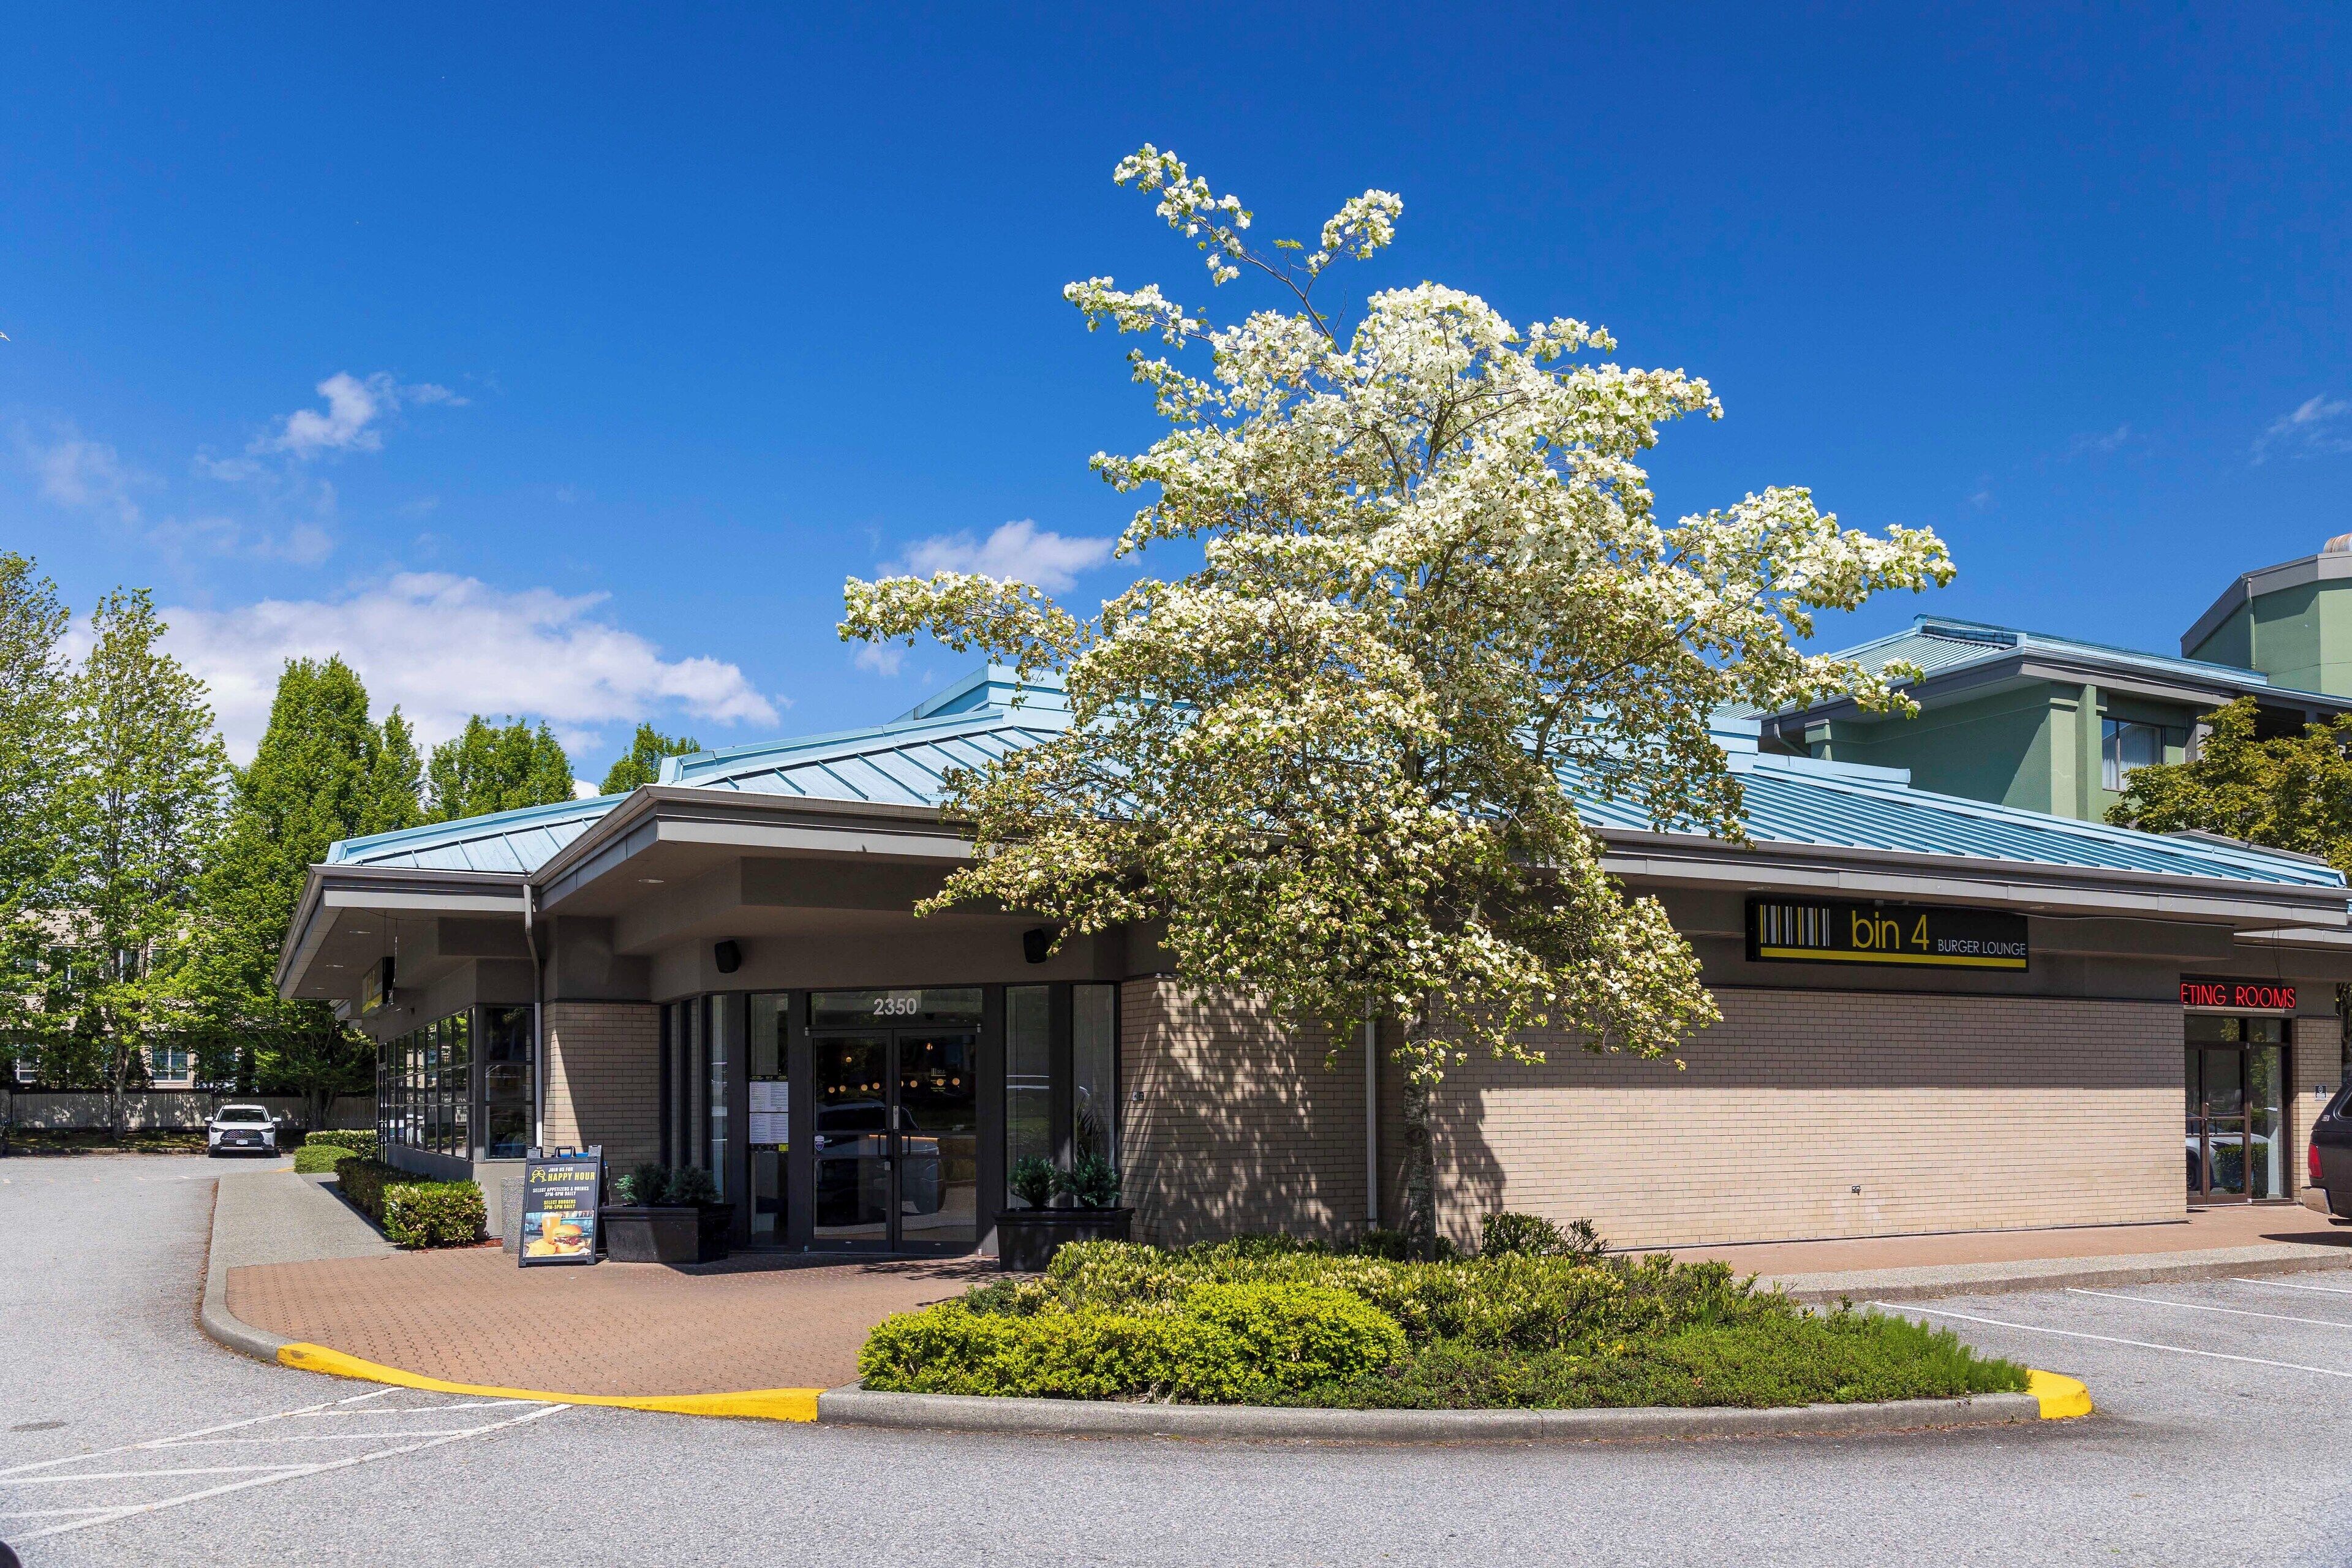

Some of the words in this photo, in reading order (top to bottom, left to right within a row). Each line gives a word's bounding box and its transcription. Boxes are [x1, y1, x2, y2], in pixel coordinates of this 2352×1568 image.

[1852, 910, 1899, 949] bin
[1911, 914, 1929, 951] 4
[1937, 939, 1979, 953] BURGER
[1982, 941, 2026, 956] LOUNGE
[2236, 986, 2295, 1008] ROOMS
[873, 998, 917, 1015] 2350
[548, 1172, 572, 1182] HAPPY
[575, 1172, 595, 1180] HOUR
